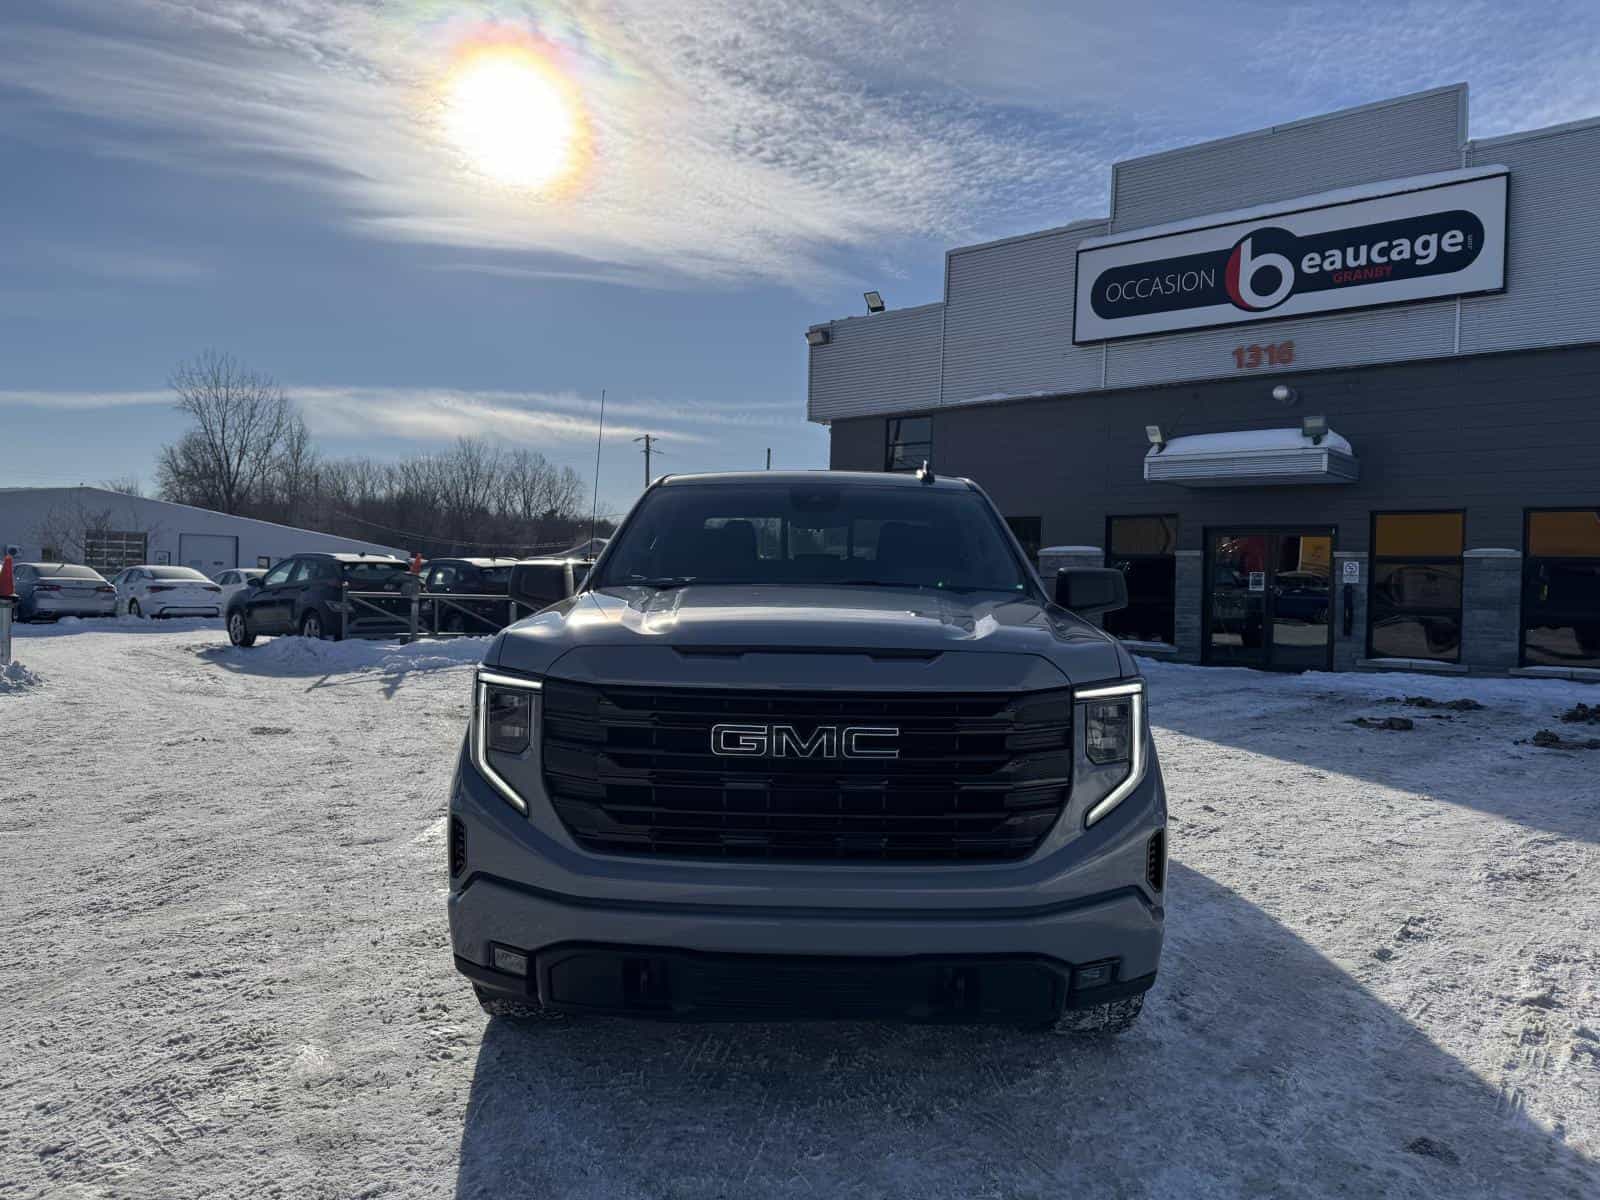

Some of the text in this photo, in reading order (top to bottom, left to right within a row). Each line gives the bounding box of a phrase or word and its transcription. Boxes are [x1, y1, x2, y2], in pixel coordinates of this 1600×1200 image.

[1105, 268, 1215, 303] OCCASION
[1332, 265, 1393, 284] GRANBY
[1232, 341, 1296, 369] 1316
[711, 724, 899, 758] GMC
